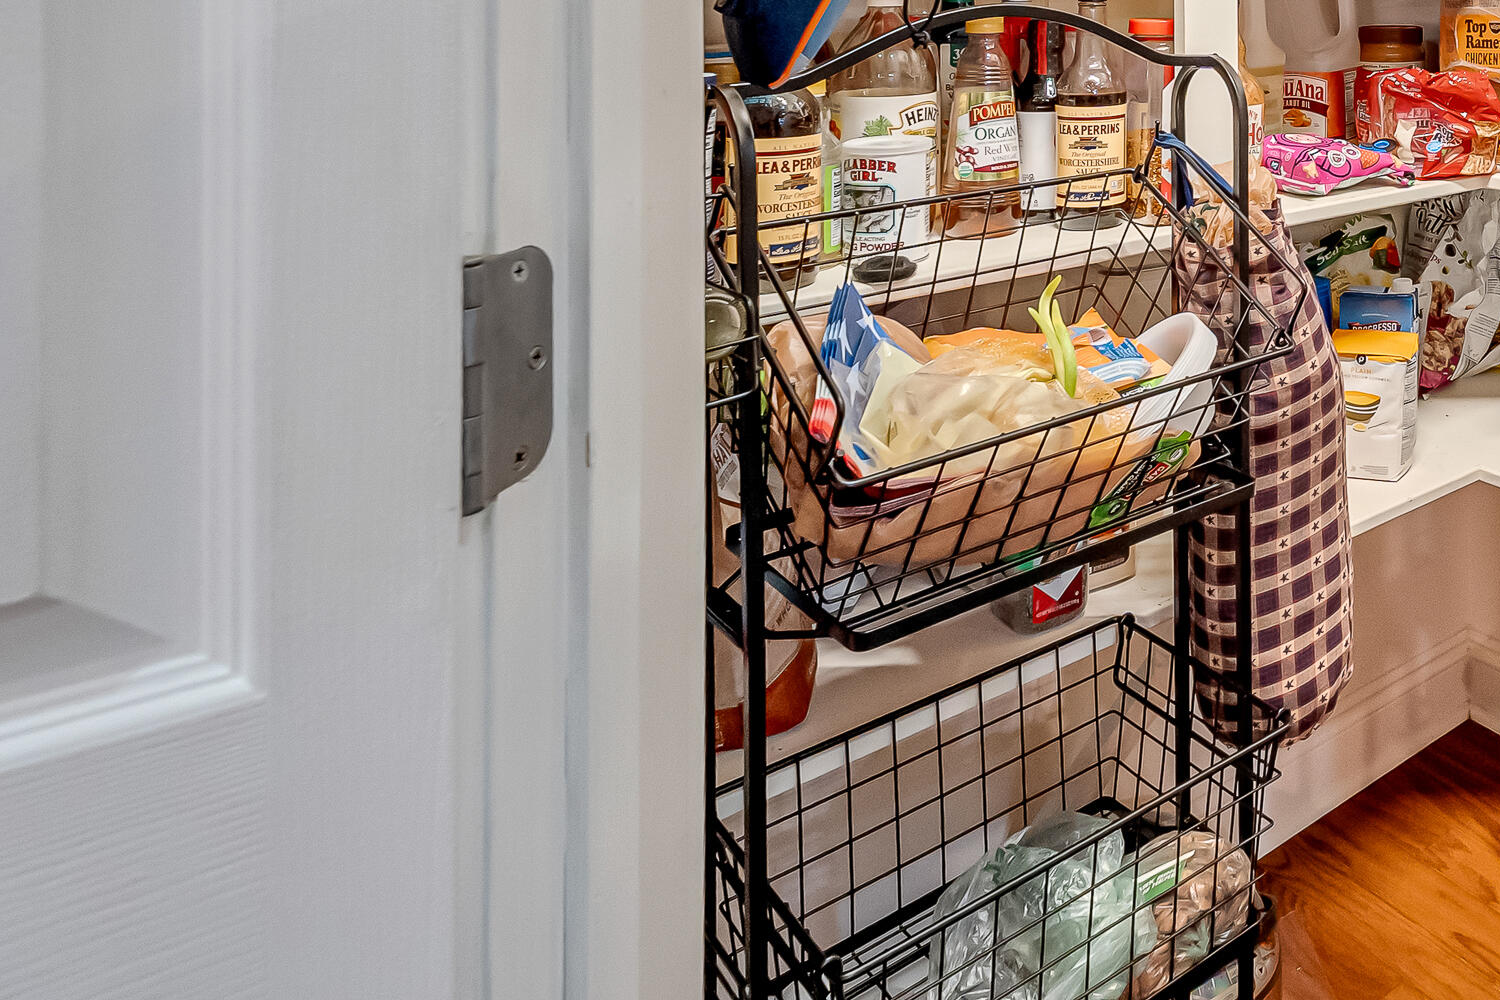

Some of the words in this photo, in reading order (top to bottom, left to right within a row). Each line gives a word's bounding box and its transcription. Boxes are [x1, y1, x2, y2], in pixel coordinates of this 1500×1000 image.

[1465, 19, 1487, 37] Top
[1465, 53, 1499, 66] CHICKEN
[974, 126, 1017, 141] ORGAN
[1059, 123, 1073, 135] LEA
[1081, 122, 1120, 136] PERRINS
[984, 144, 1002, 156] Red
[850, 171, 879, 182] GIRL
